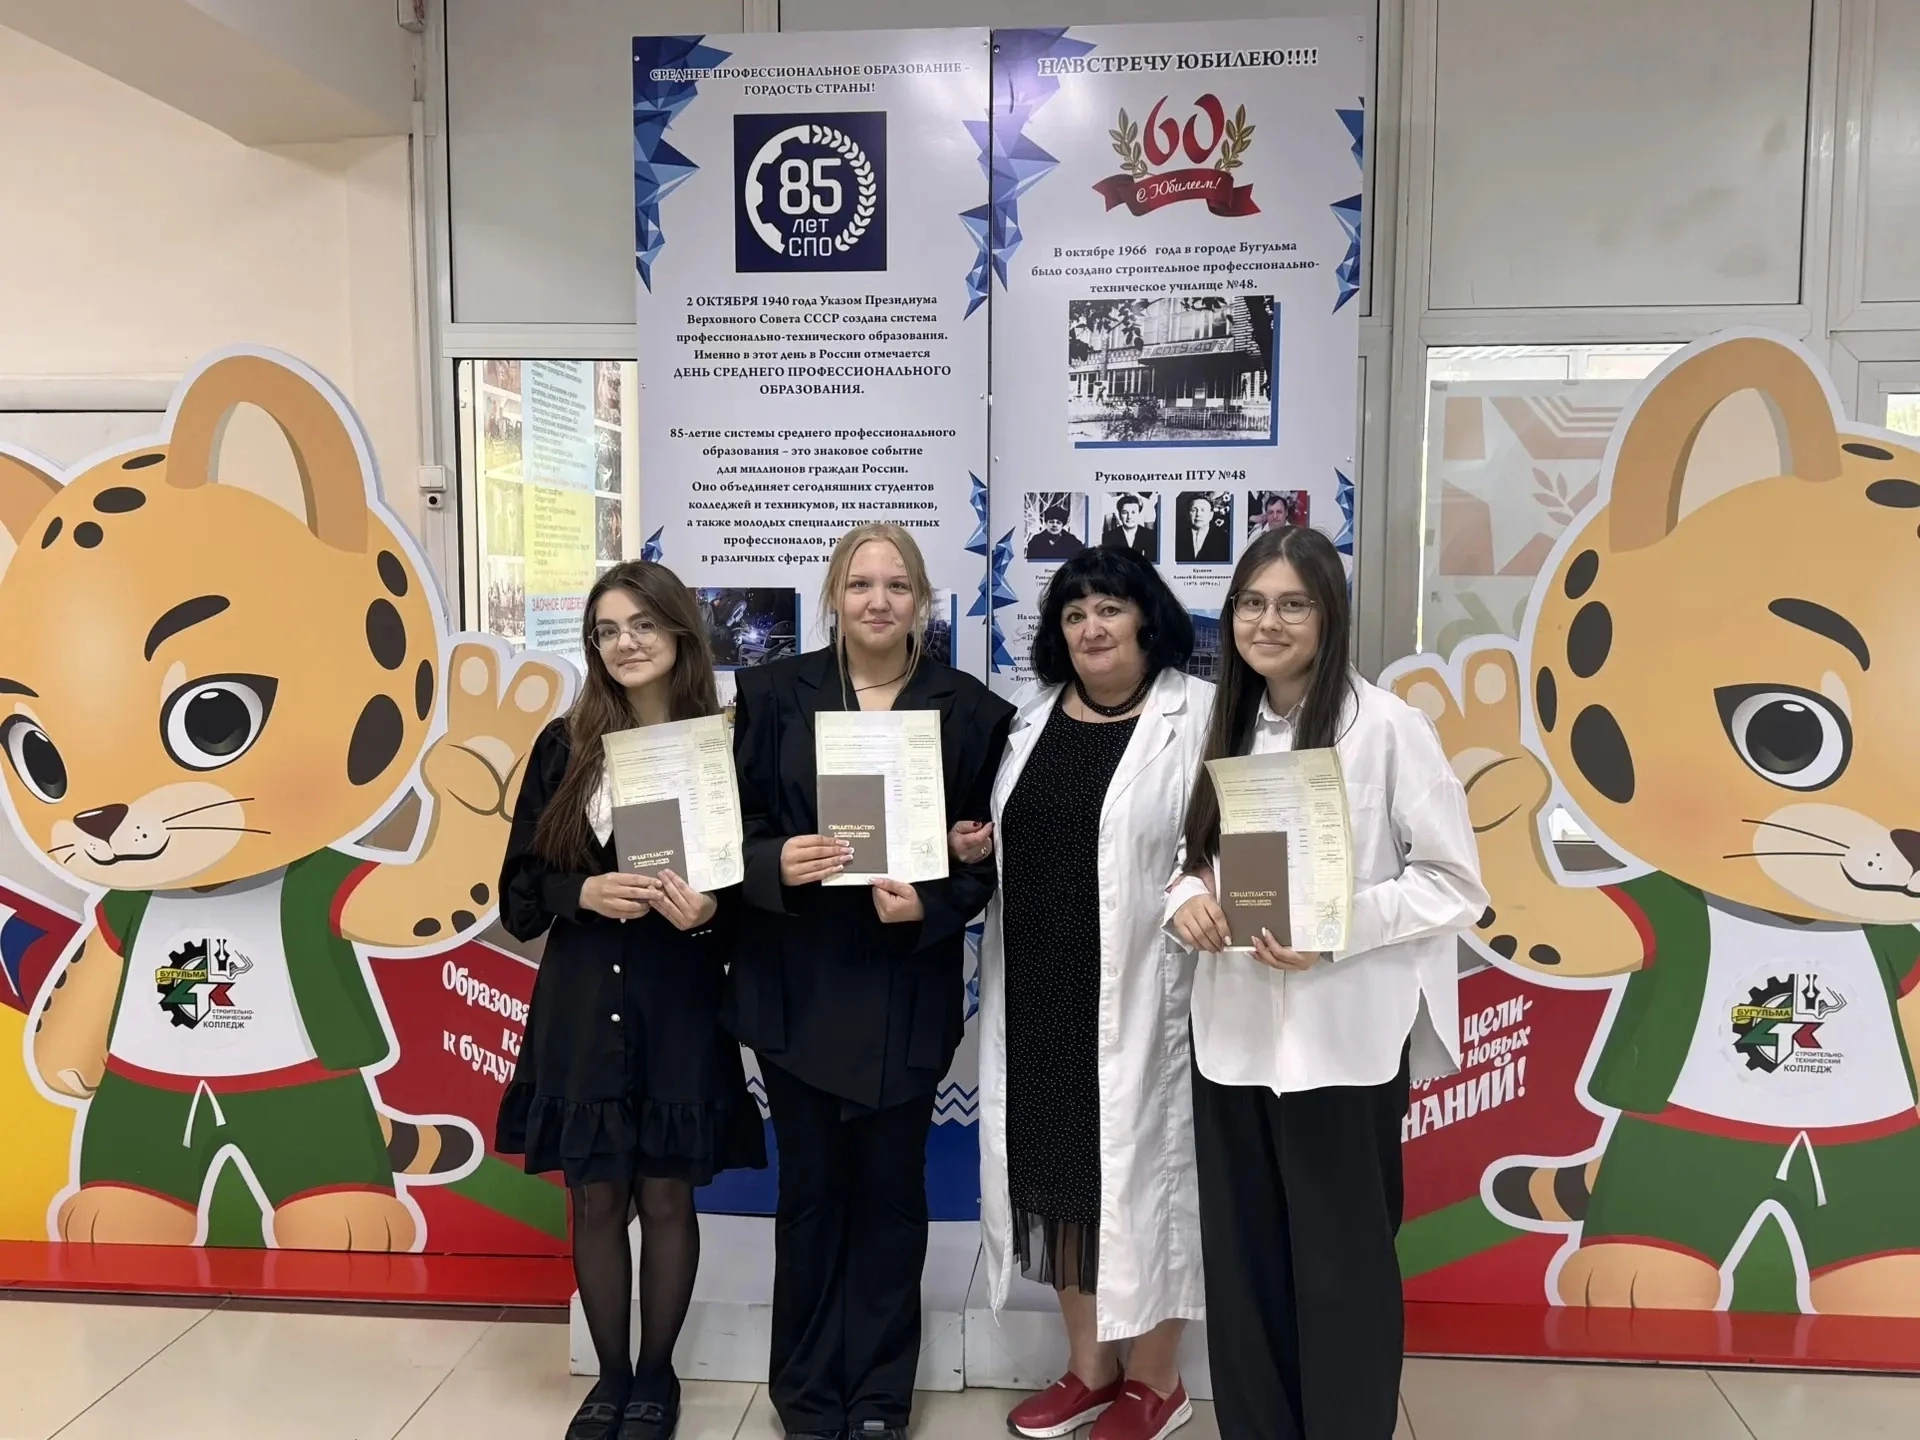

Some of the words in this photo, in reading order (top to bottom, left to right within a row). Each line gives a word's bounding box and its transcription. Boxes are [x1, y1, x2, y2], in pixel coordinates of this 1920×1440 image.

[1039, 55, 1173, 75] НАВСТРЕЧУ
[1178, 49, 1318, 69] ЮБИЛЕЮ!!!!
[650, 68, 710, 82] СРЕДНЕЕ
[713, 65, 861, 79] ПРОФЕССИОНАЛЬНОЕ
[863, 62, 963, 76] ОБРАЗОВАНИЕ
[744, 83, 812, 97] ГОРДОСТЬ
[815, 82, 876, 95] СТРАНЫ!
[1143, 93, 1224, 166] 60
[779, 158, 843, 215] 85
[1150, 177, 1221, 199] Юбилеем!
[792, 218, 830, 233] лет
[788, 237, 832, 257] СПО
[1054, 248, 1062, 257] В
[1066, 246, 1114, 259] октябре
[1119, 245, 1146, 256] 1966
[1156, 247, 1181, 255] года
[1195, 245, 1236, 255] городе
[1240, 242, 1296, 254] Бугульма
[1032, 266, 1062, 276] было
[1065, 267, 1112, 276] создано
[1116, 265, 1199, 276] строительное
[1203, 261, 1319, 274] профессионально-
[1090, 284, 1166, 292] техническое
[1169, 283, 1223, 293] училище
[1227, 279, 1257, 289] №48.
[687, 297, 693, 306] 2
[696, 296, 758, 306] ОКТЯБРЯ
[763, 296, 789, 305] 1940
[792, 299, 817, 307] года
[820, 296, 862, 305] Указом
[865, 295, 937, 307] Президиума
[688, 315, 756, 326] Верховного
[760, 314, 800, 323] Совета
[804, 313, 839, 323] СССР
[843, 316, 887, 324] создана
[677, 333, 865, 344] профессионально-технического
[869, 331, 947, 343] образования.
[695, 350, 740, 359] Именно
[781, 352, 806, 360] день
[820, 349, 860, 358] России
[674, 368, 710, 379] ДЕНЬ
[714, 367, 784, 378] СРЕДНЕГО
[788, 366, 951, 376] ПРОФЕССИОНАЛЬНОГО
[760, 385, 864, 394] ОБРАЗОВАНИЯ.
[670, 429, 721, 438] 85-летие
[778, 431, 831, 440] среднего
[835, 428, 956, 440] профессионального
[703, 446, 779, 458] образования
[872, 445, 923, 455] событие
[717, 467, 737, 475] для
[809, 467, 858, 476] граждан
[862, 464, 908, 473] России.
[1096, 472, 1182, 483] Руководители
[1186, 470, 1215, 480] ПТУ
[1219, 470, 1245, 480] №48
[692, 482, 716, 491] Оно
[720, 481, 790, 492] объединяет
[793, 484, 871, 492] сегодняшних
[875, 484, 934, 494] студентов
[689, 500, 751, 510] колледжей
[764, 502, 838, 512] техникумов,
[859, 502, 937, 511] наставников,
[734, 520, 785, 528] молодых
[724, 536, 825, 547] профессионалов,
[711, 555, 774, 564] различных
[778, 553, 819, 565] сферах
[1737, 1008, 1790, 1016] БУГУЛЬМА
[203, 1021, 245, 1029] КОЛЛЕДЖ
[443, 1029, 456, 1055] к
[1467, 1026, 1531, 1068] новых
[1783, 1065, 1832, 1073] КОЛЛЕДЖ
